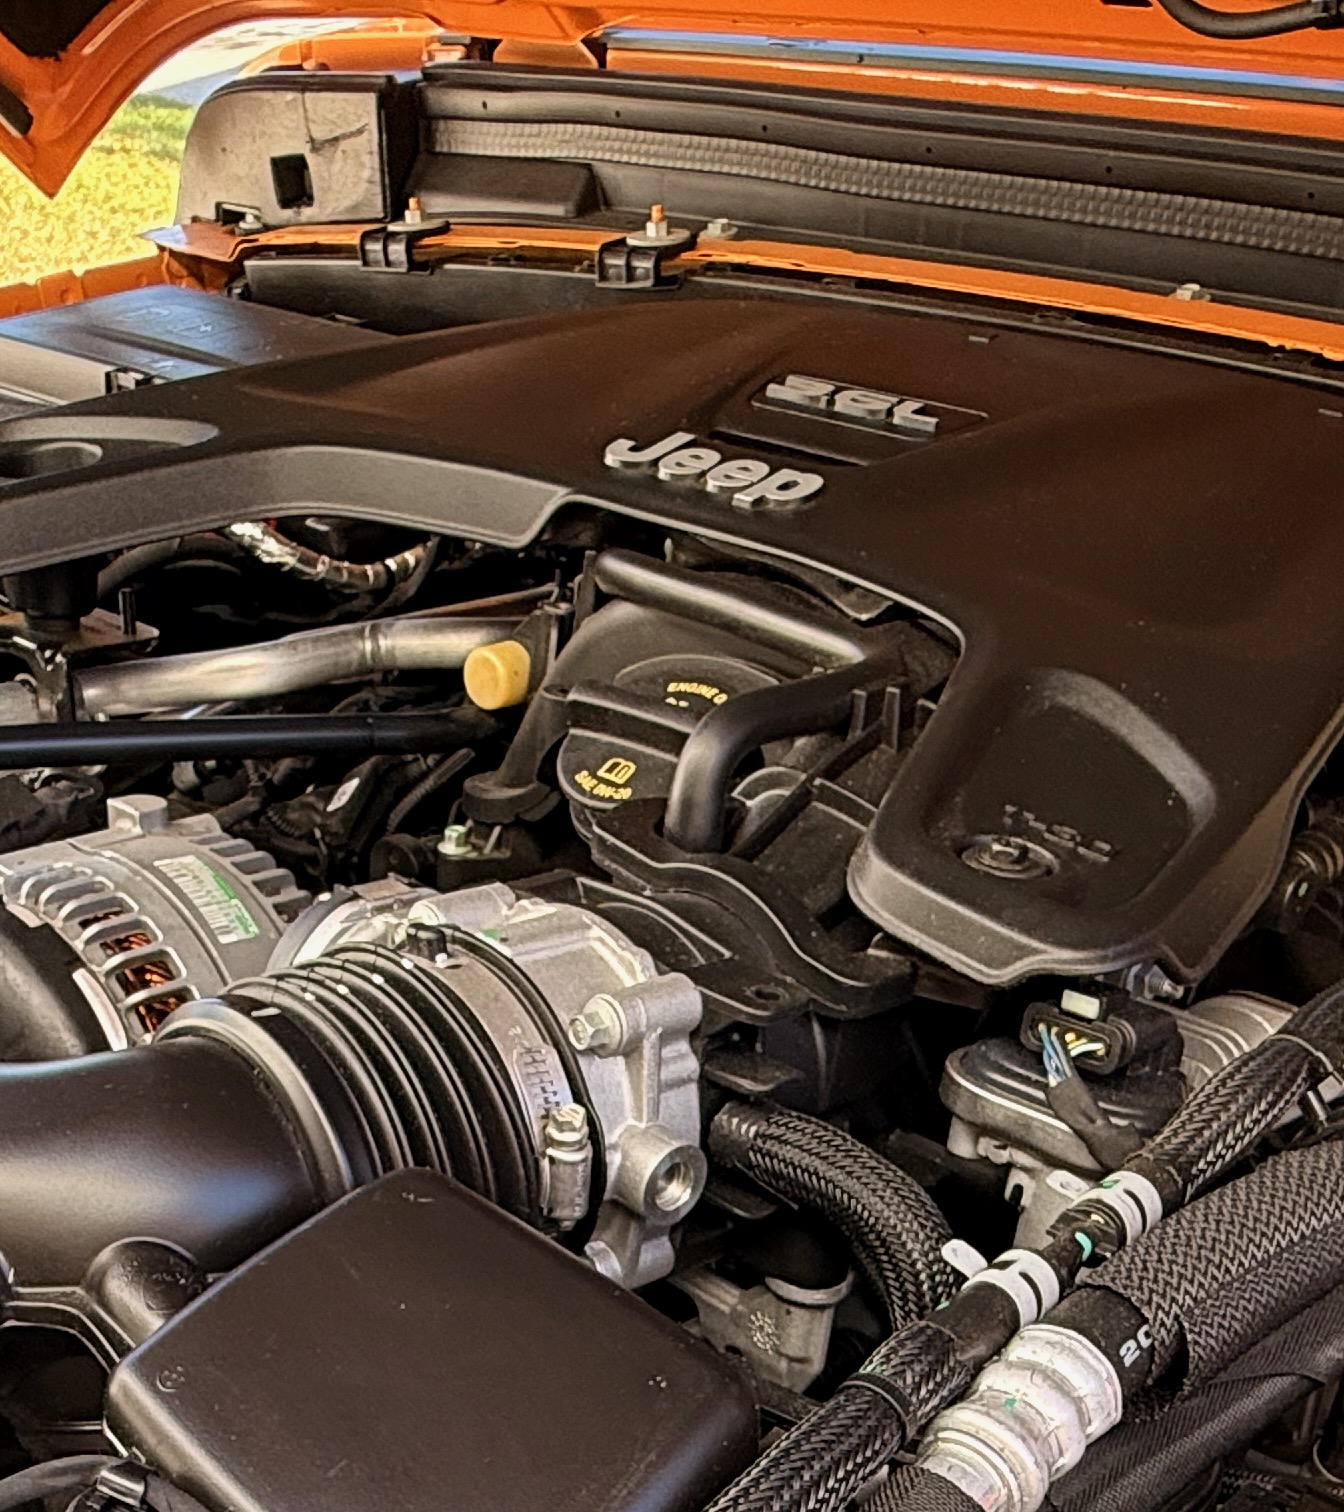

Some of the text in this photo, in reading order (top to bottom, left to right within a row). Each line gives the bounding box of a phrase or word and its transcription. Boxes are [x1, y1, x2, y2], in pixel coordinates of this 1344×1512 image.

[603, 431, 825, 509] Jeep
[666, 681, 729, 706] ENGINE O
[574, 769, 633, 800] SAE 0W-20
